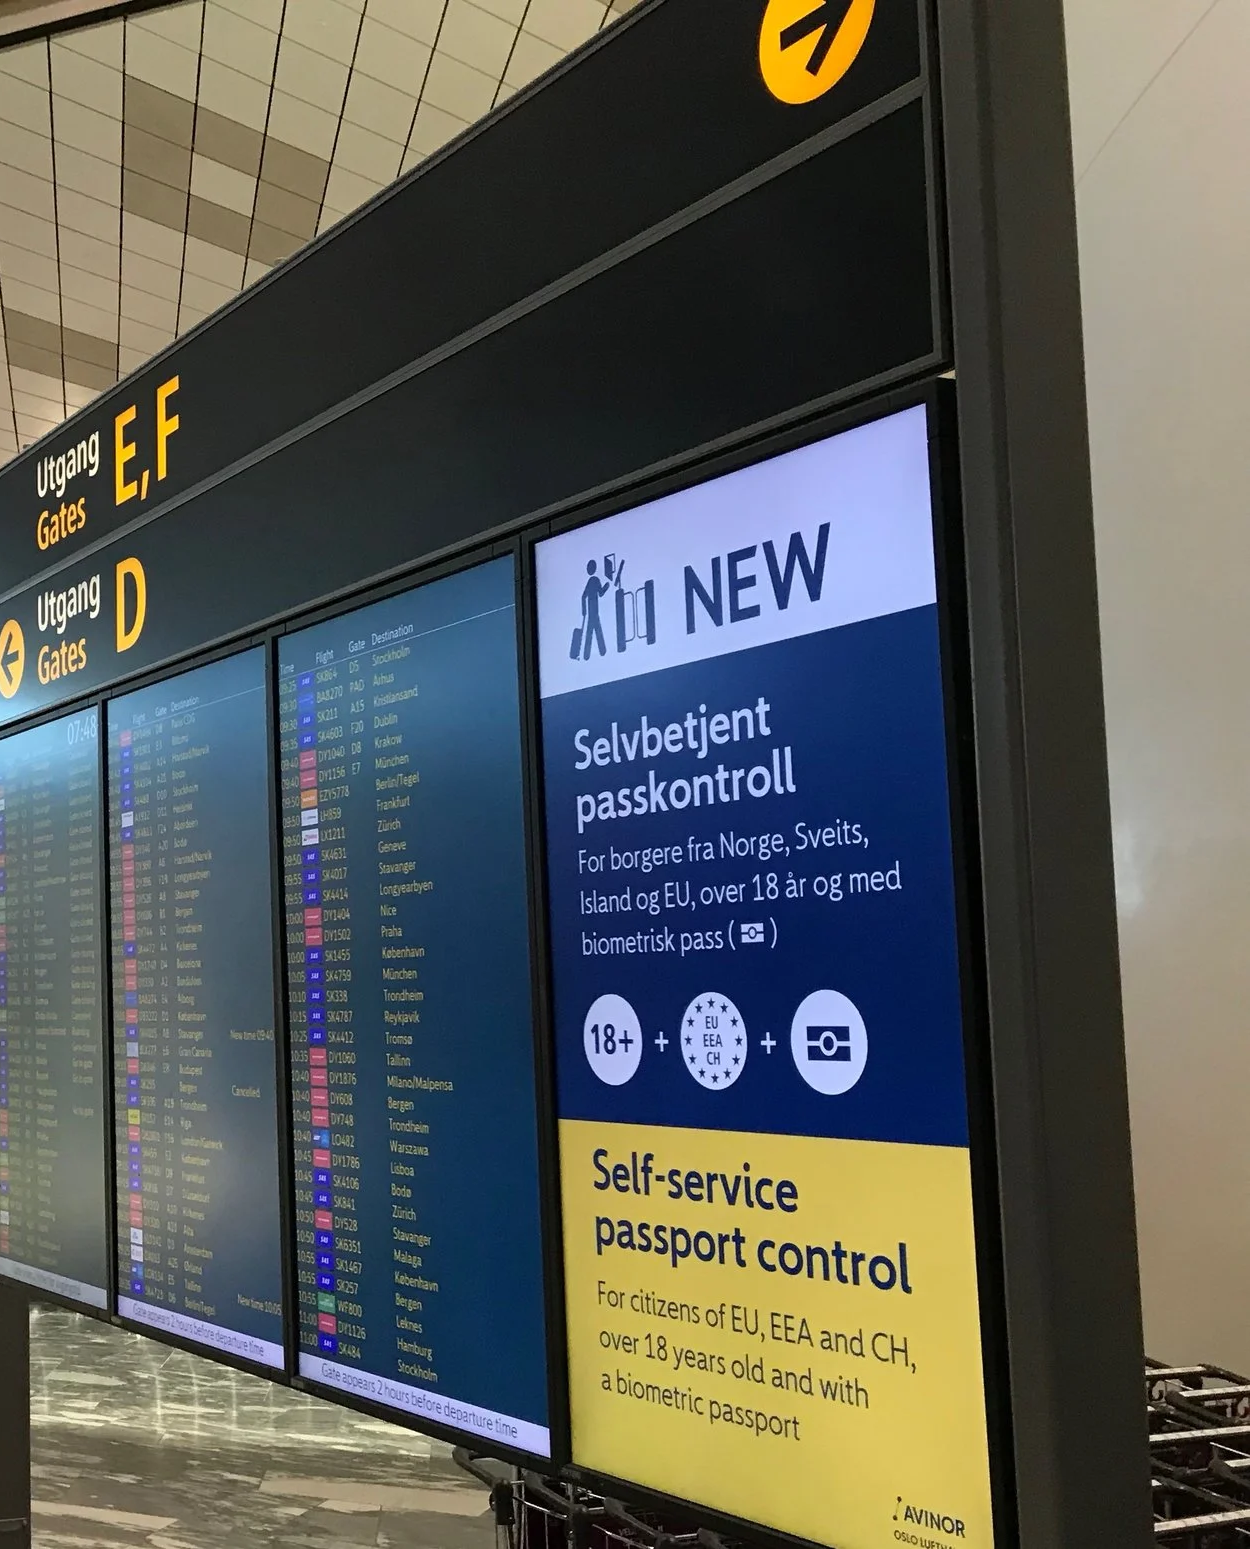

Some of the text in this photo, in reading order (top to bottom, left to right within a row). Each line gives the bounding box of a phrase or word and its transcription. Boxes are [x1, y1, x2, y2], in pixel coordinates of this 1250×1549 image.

[37, 375, 179, 506] Utgang E,F
[37, 497, 86, 550] Gates
[684, 522, 831, 635] NEW
[37, 557, 146, 653] Utgang D
[349, 639, 366, 653] Gate
[371, 623, 414, 646] Destination
[37, 637, 87, 685] Gates
[317, 707, 337, 723] SK211
[374, 712, 397, 728] Dublin
[67, 714, 97, 745] 07:48
[574, 697, 771, 770] Selvbetjent
[374, 732, 402, 749] Krakow
[375, 752, 409, 769] München
[375, 772, 419, 793] Berlin/Tegel
[577, 746, 796, 834] passkontroll
[376, 795, 410, 811] Frankfurt
[378, 839, 406, 853] Geneve
[579, 819, 869, 874] For borgere fra Norge, Sveits,
[378, 860, 416, 877] Stavanger
[379, 880, 433, 898] Longyearbyen
[581, 861, 902, 915] Island og EU, over 18 år og med
[380, 904, 396, 916] Nice
[381, 925, 402, 937] Praha
[582, 926, 675, 955] biometrisk
[680, 931, 724, 957] pass
[382, 946, 424, 958] København
[382, 968, 417, 979] München
[383, 990, 423, 1001] Trondheim
[384, 1011, 419, 1026] Reykjavik
[385, 1032, 412, 1045] Tromsø
[591, 1023, 634, 1055] 18+
[705, 1016, 718, 1029] EU
[703, 1034, 723, 1047] EEA
[386, 1054, 410, 1066] Tallinn
[706, 1051, 721, 1065] CH
[386, 1075, 453, 1095] Milano/Malpensa
[387, 1097, 414, 1113] Bergen
[389, 1118, 429, 1135] Trondheim
[389, 1140, 429, 1157] Warszawa
[390, 1162, 414, 1177] Lisboa
[593, 1148, 798, 1213] Self-service
[391, 1184, 411, 1199] Bodø
[392, 1205, 416, 1222] Zürich
[393, 1228, 431, 1250] Stavanger
[393, 1249, 422, 1270] Malaga
[596, 1216, 912, 1294] passport control
[394, 1271, 438, 1294] København
[395, 1293, 422, 1315] Bergen
[396, 1315, 422, 1334] Leknes
[598, 1280, 916, 1374] For citizens of EU, EEA and CH,
[397, 1337, 432, 1362] Hamburg
[397, 1359, 437, 1384] Stockholm
[600, 1331, 869, 1409] over 18 years old and with
[322, 1363, 518, 1438] Gate appears 2 hours before departure time
[602, 1369, 800, 1441] a biometric passport
[904, 1505, 965, 1538] AVINOR
[894, 1530, 918, 1545] OSLO
